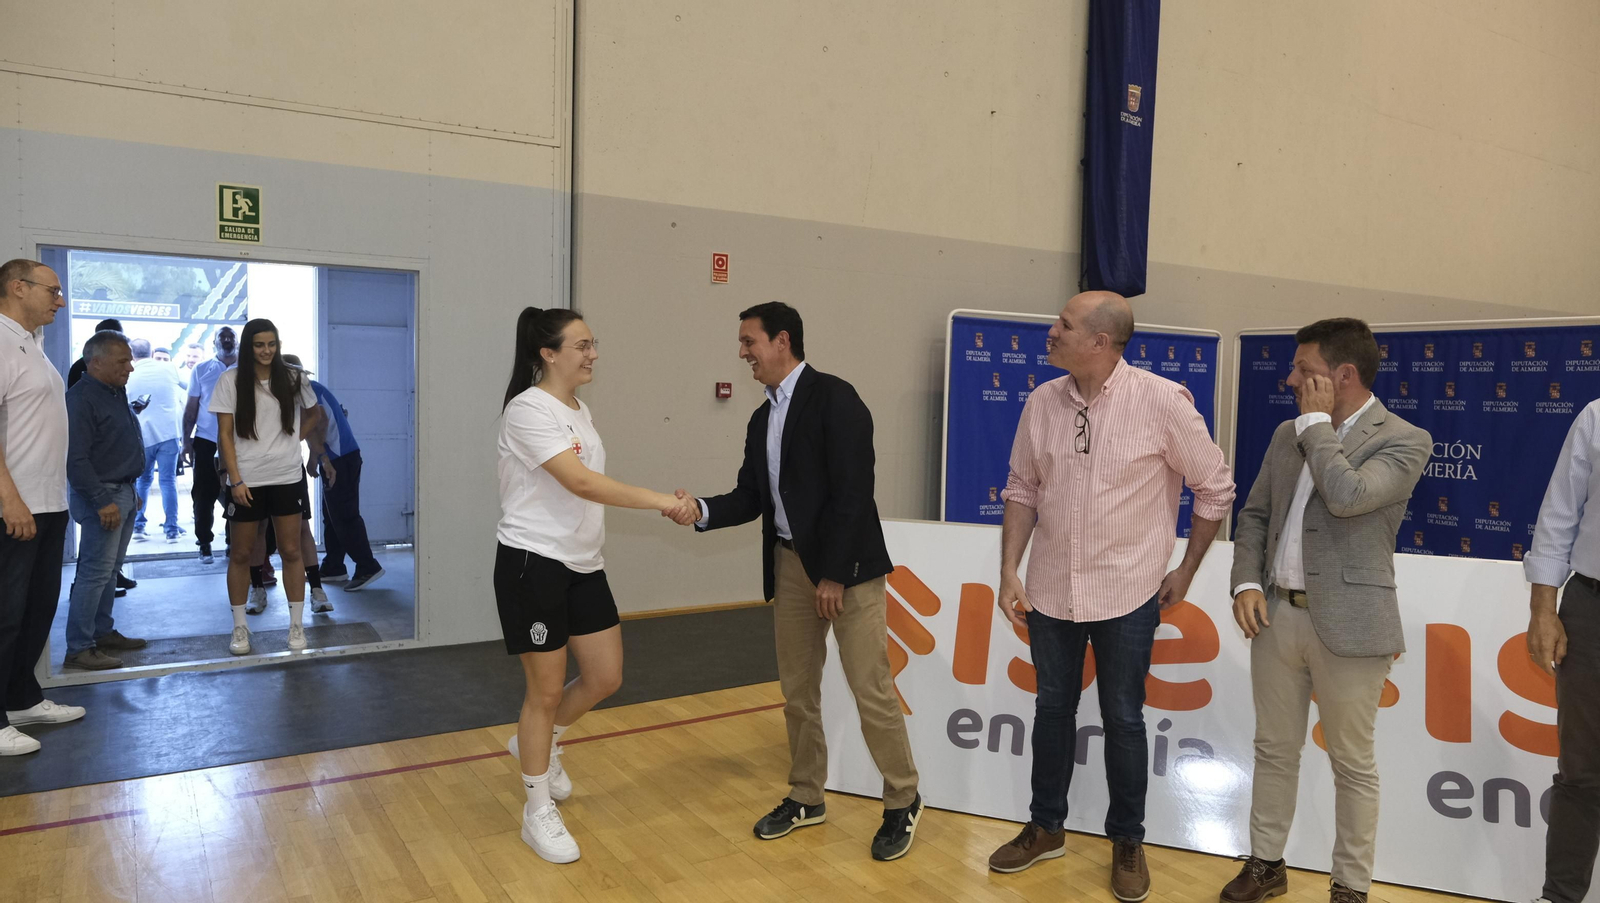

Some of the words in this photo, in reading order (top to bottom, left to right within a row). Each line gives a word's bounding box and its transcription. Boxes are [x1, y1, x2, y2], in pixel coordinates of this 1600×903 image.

[78, 302, 171, 317] #VAMOSVERDES
[1427, 513, 1459, 521] DIPUTACIÓN
[1435, 519, 1458, 527] ALMERÍA
[1475, 518, 1511, 527] DIPUTACIÓN
[1427, 770, 1556, 828] en
